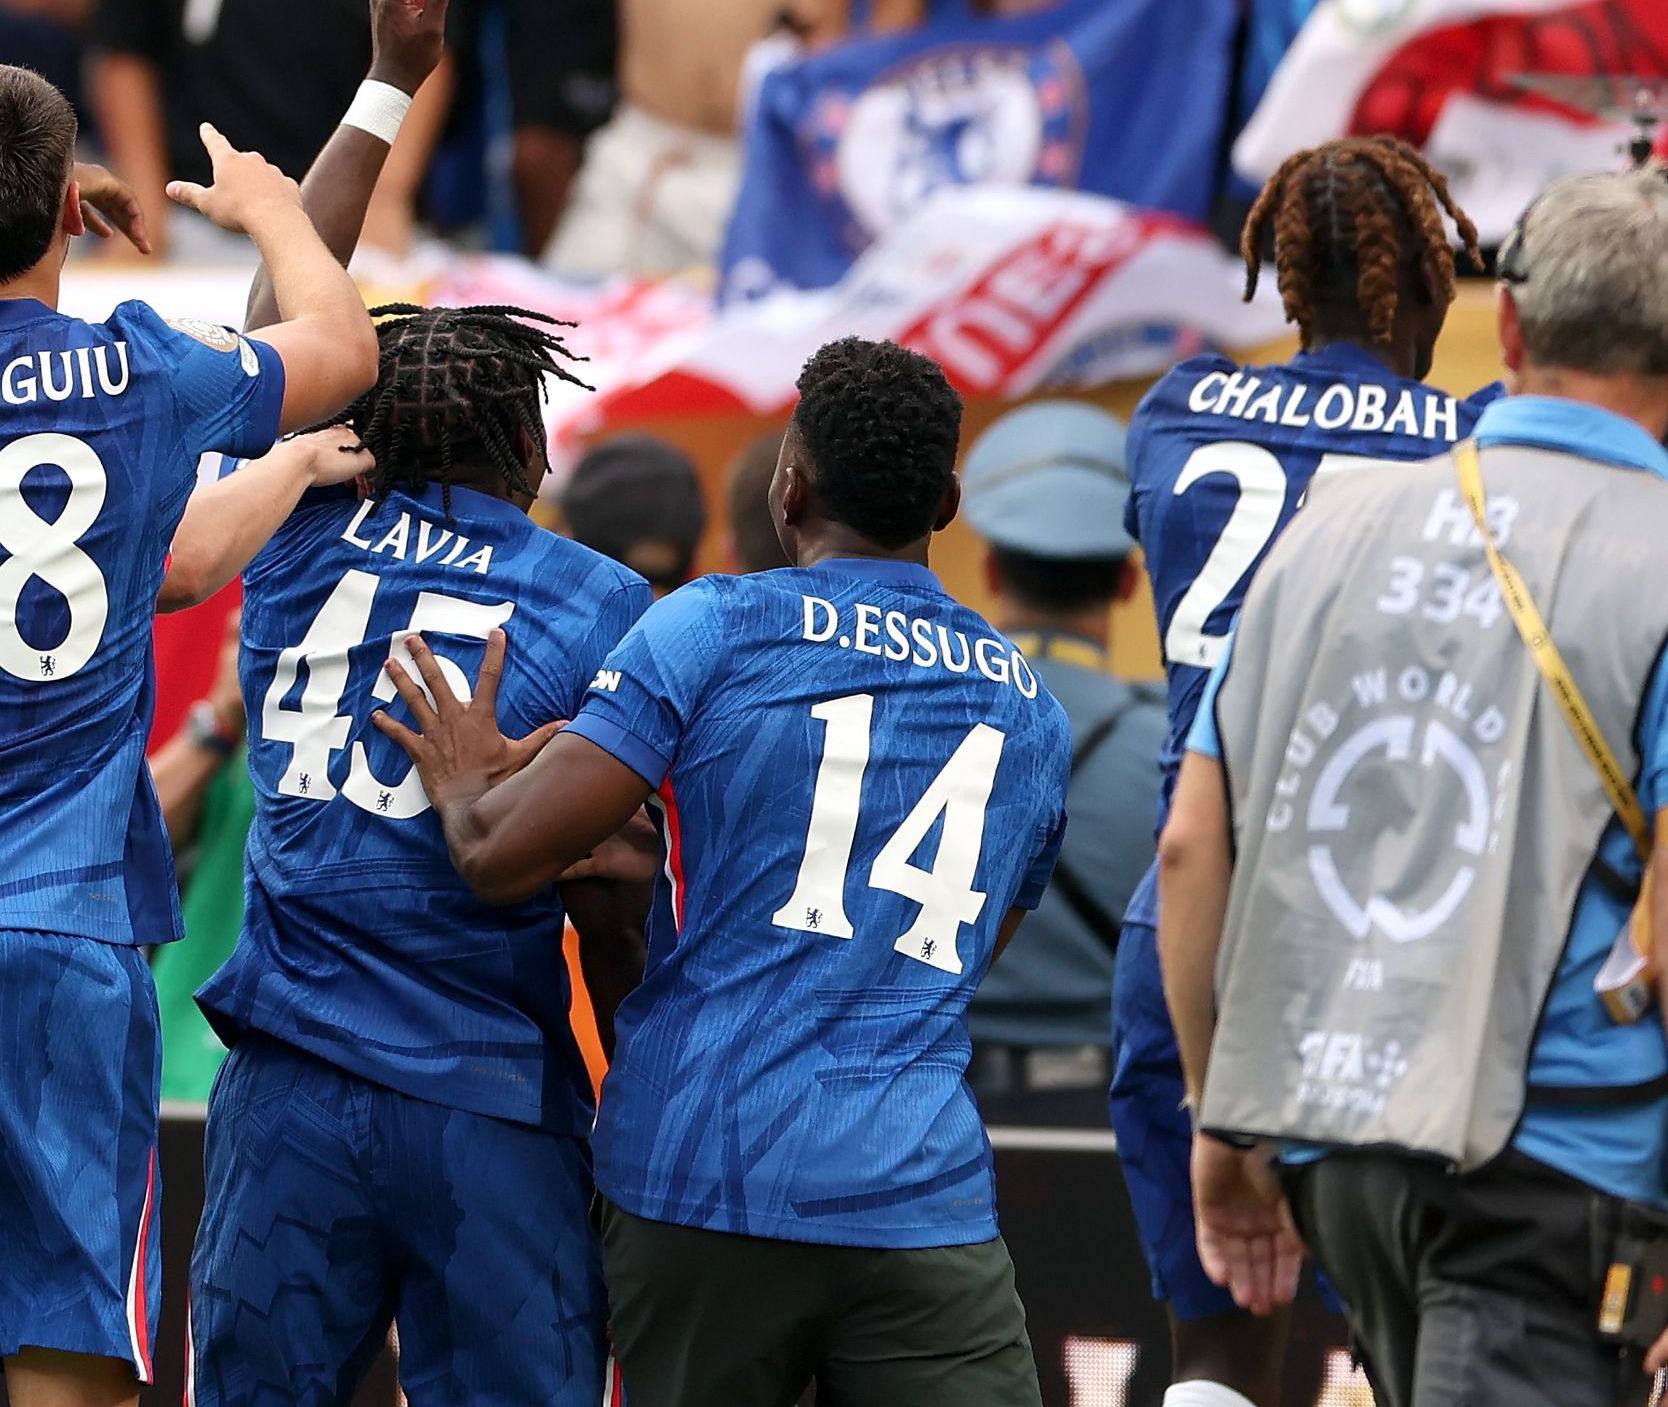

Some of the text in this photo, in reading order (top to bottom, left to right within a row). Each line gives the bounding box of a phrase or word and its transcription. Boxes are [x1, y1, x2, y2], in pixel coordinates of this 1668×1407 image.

[0, 340, 131, 404] GUIU
[1187, 370, 1459, 442] CHALOBAH
[340, 497, 495, 576] LAVIA
[1165, 440, 1429, 670] 2
[1375, 554, 1503, 629] 334
[261, 568, 516, 820] 45
[801, 595, 1040, 700] D.ESSUGO
[1265, 700, 1340, 834] CLUB
[1351, 664, 1508, 745] WORLD
[771, 693, 1006, 976] 14
